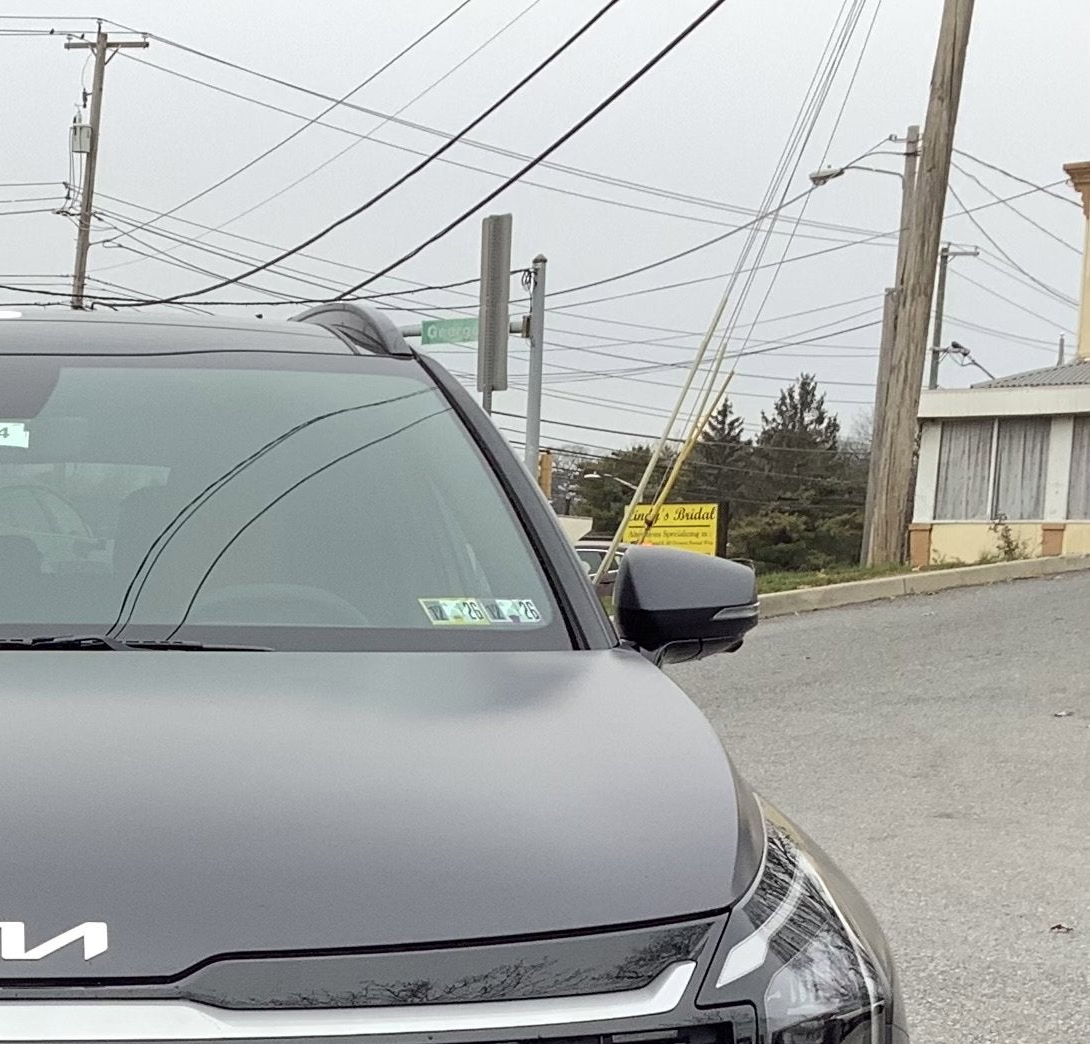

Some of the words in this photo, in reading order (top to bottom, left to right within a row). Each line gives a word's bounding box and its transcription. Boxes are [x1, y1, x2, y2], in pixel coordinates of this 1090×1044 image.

[673, 506, 716, 521] Bridal
[462, 601, 484, 620] 26
[519, 601, 540, 620] 26
